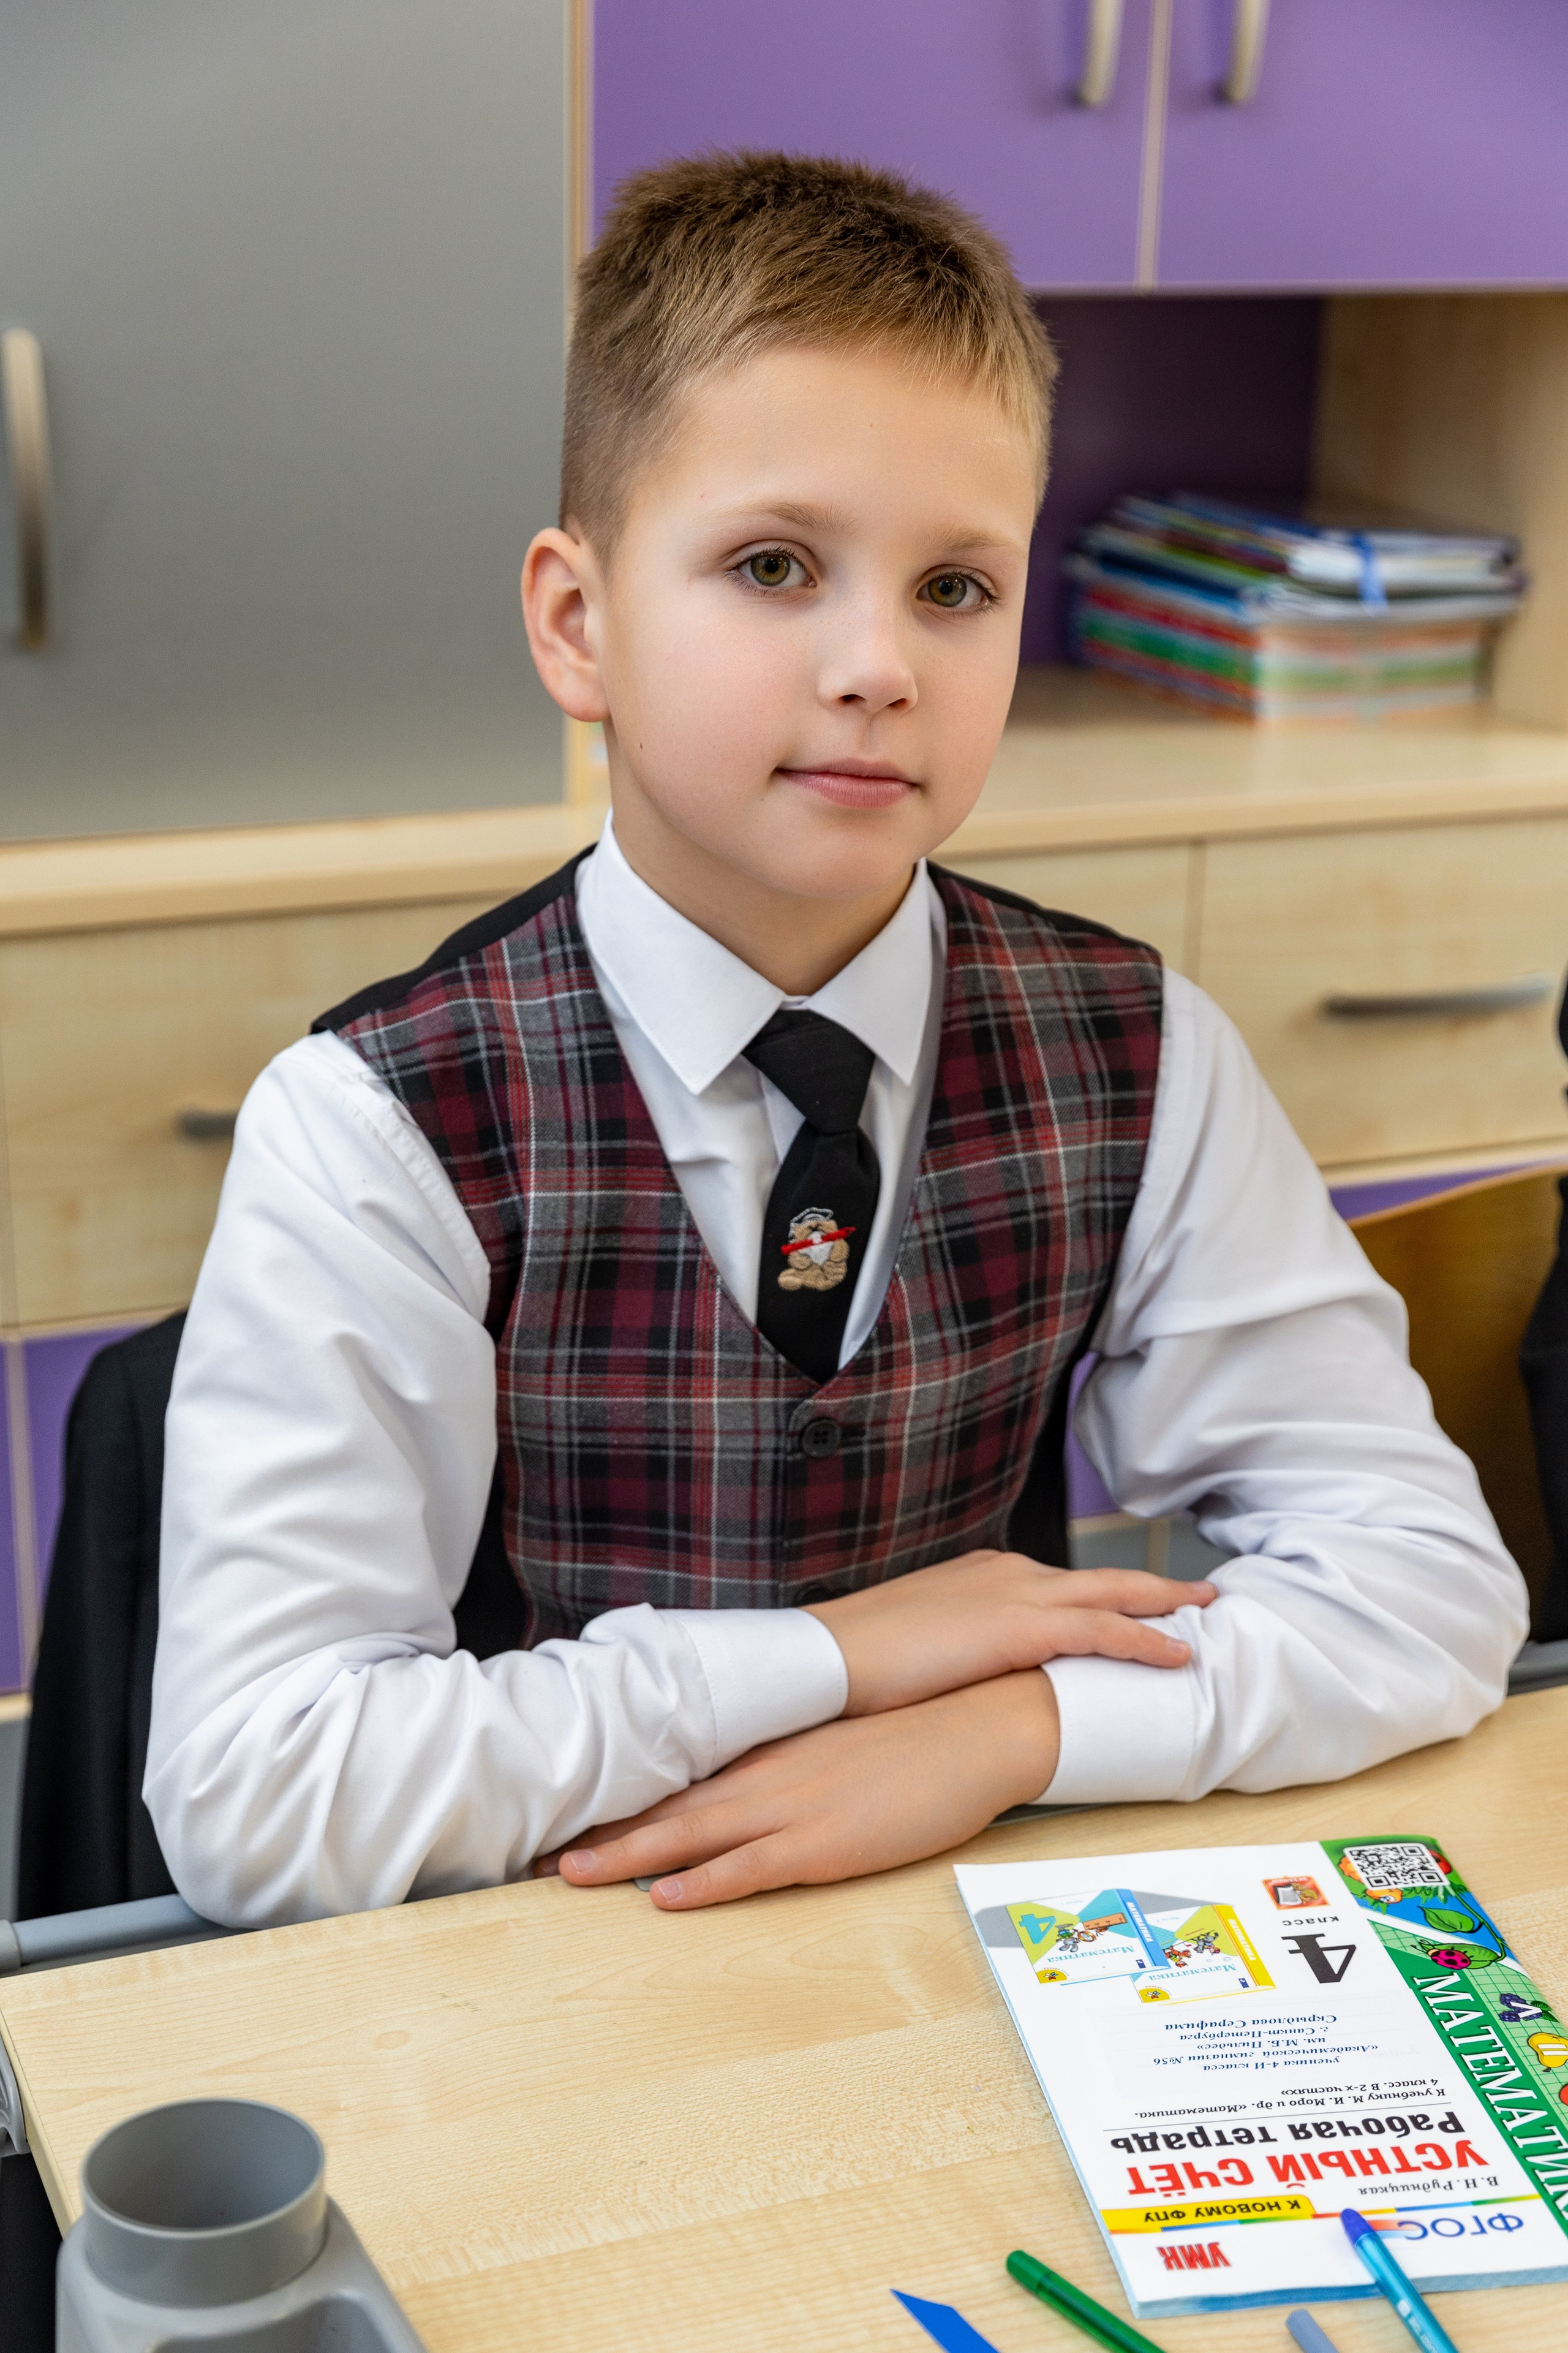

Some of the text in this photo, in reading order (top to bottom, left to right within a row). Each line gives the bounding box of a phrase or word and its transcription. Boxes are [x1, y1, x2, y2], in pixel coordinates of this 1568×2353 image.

[1282, 1916, 1340, 1926] класс
[1019, 1913, 1056, 1944] 4
[1047, 1945, 1135, 1963] Математика
[1281, 1933, 1357, 1984] 4
[1148, 1963, 1238, 1982] Математика
[1164, 2014, 1338, 2031] Скрыдлова Серафима
[1180, 2027, 1315, 2041] Санкт-Петербурга
[1196, 2041, 1262, 2050] Пильдес»
[1267, 2038, 1298, 2047] М.Б.
[1188, 2052, 1254, 2061] гимназии
[1262, 2044, 1379, 2058] «Академической
[1153, 2056, 1183, 2066] №56
[1203, 2055, 1340, 2071] ученика 4-И класса
[1384, 2079, 1427, 2088] класс.
[1281, 2086, 1343, 2096] частях»
[1368, 2088, 1433, 2100] учебнику
[1251, 2101, 1273, 2110] др.
[1289, 2098, 1325, 2107] Моро
[1134, 2104, 1246, 2118] «Математика.
[1110, 2111, 1466, 2154] Рабочая тетрадь
[1126, 2139, 1490, 2199] УСТНЫЙ СЧЁТ
[1144, 2199, 1302, 2223] К НОВОМУ ФПУ
[1397, 2213, 1524, 2240] ФГОС
[1155, 2242, 1233, 2271] УМК
